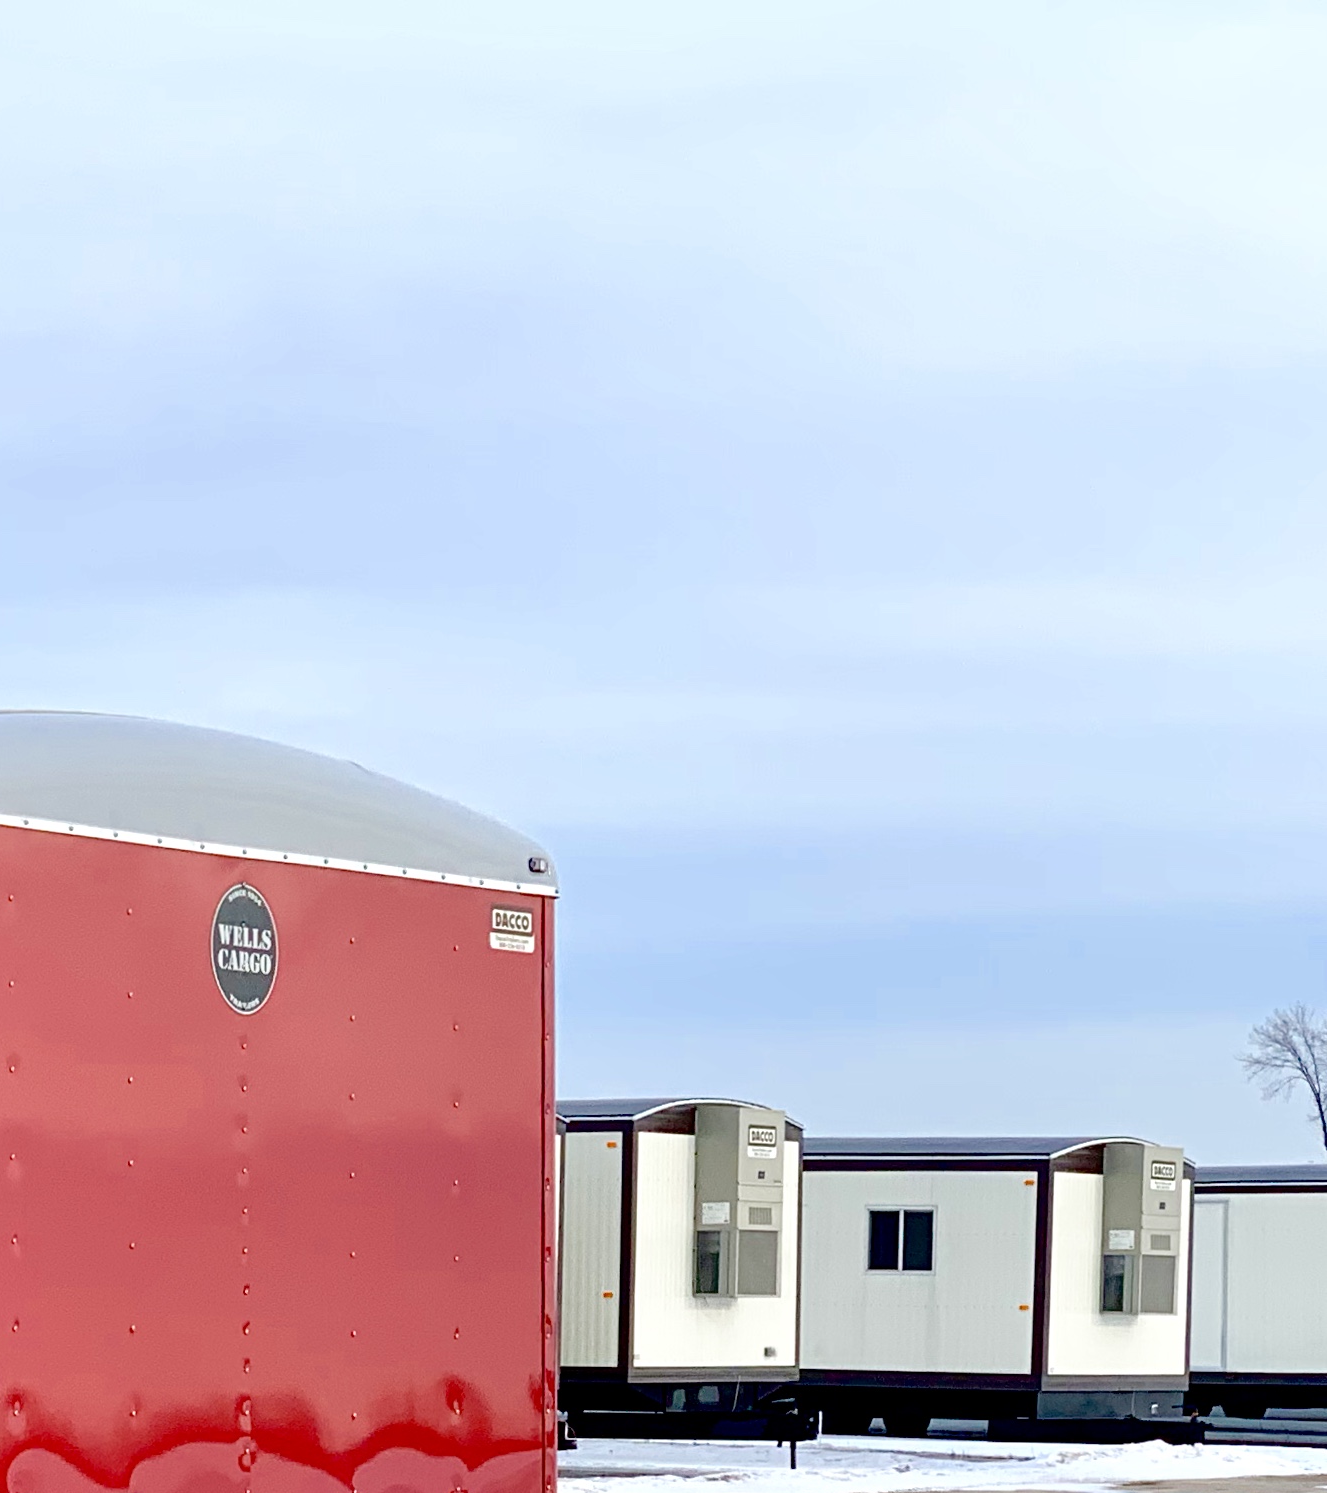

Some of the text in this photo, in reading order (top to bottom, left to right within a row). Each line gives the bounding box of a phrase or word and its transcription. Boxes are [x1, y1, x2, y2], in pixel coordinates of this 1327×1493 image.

[495, 912, 529, 930] DACCO
[218, 923, 272, 950] WELLS
[218, 949, 272, 975] CARGO
[751, 1130, 773, 1142] DACCO
[1154, 1166, 1173, 1177] DACCO
